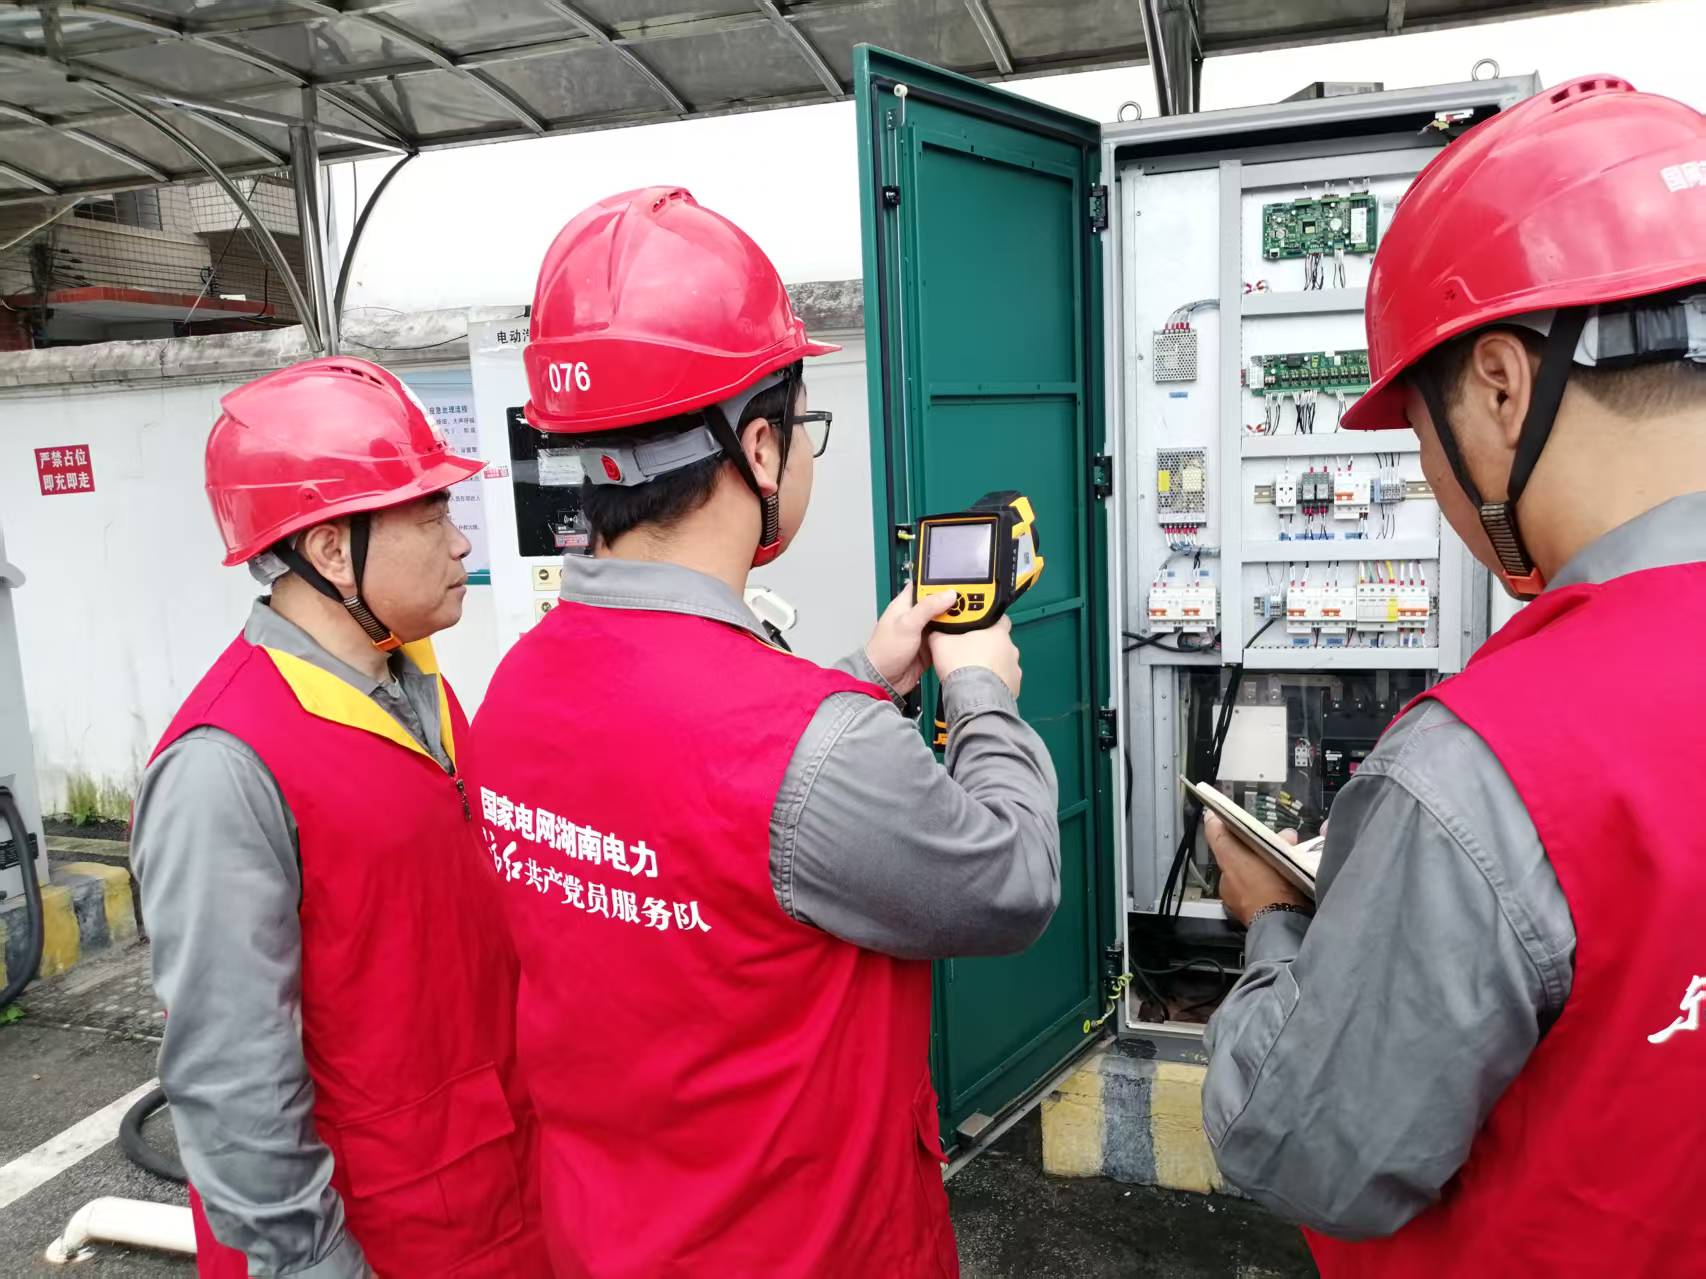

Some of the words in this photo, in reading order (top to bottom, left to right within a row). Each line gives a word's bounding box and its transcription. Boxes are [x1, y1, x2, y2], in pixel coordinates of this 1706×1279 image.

[548, 361, 591, 393] 076
[39, 448, 88, 469] 严禁占位
[42, 472, 91, 491] 即充即走
[480, 786, 659, 878] 国家电网湖南电力
